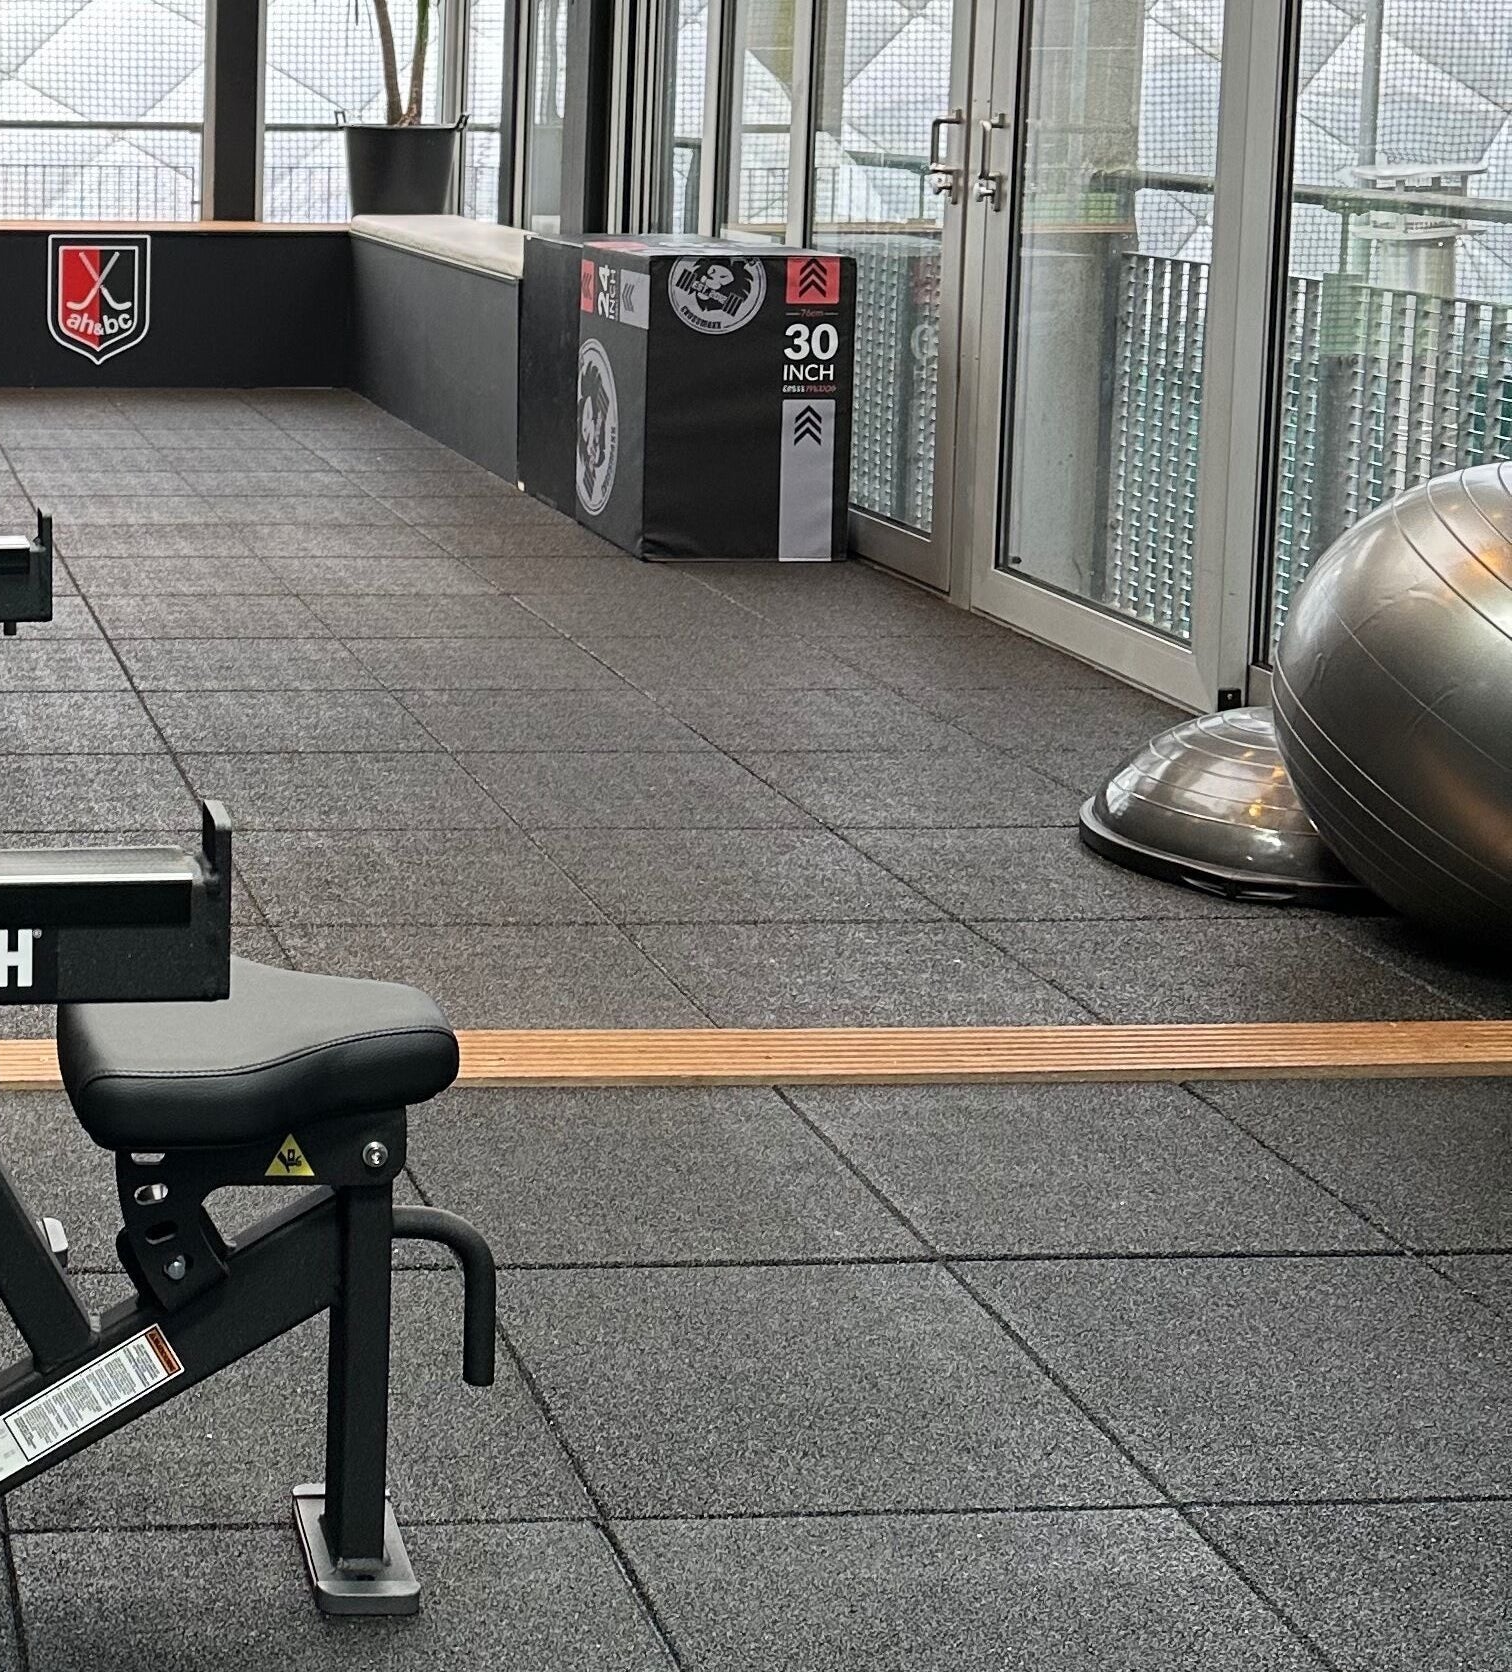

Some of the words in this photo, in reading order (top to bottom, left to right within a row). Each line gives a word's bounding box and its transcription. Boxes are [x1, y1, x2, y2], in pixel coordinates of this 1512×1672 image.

[597, 264, 610, 318] 24
[66, 313, 133, 336] ah&bc
[783, 323, 839, 360] 30
[783, 363, 834, 381] INCH
